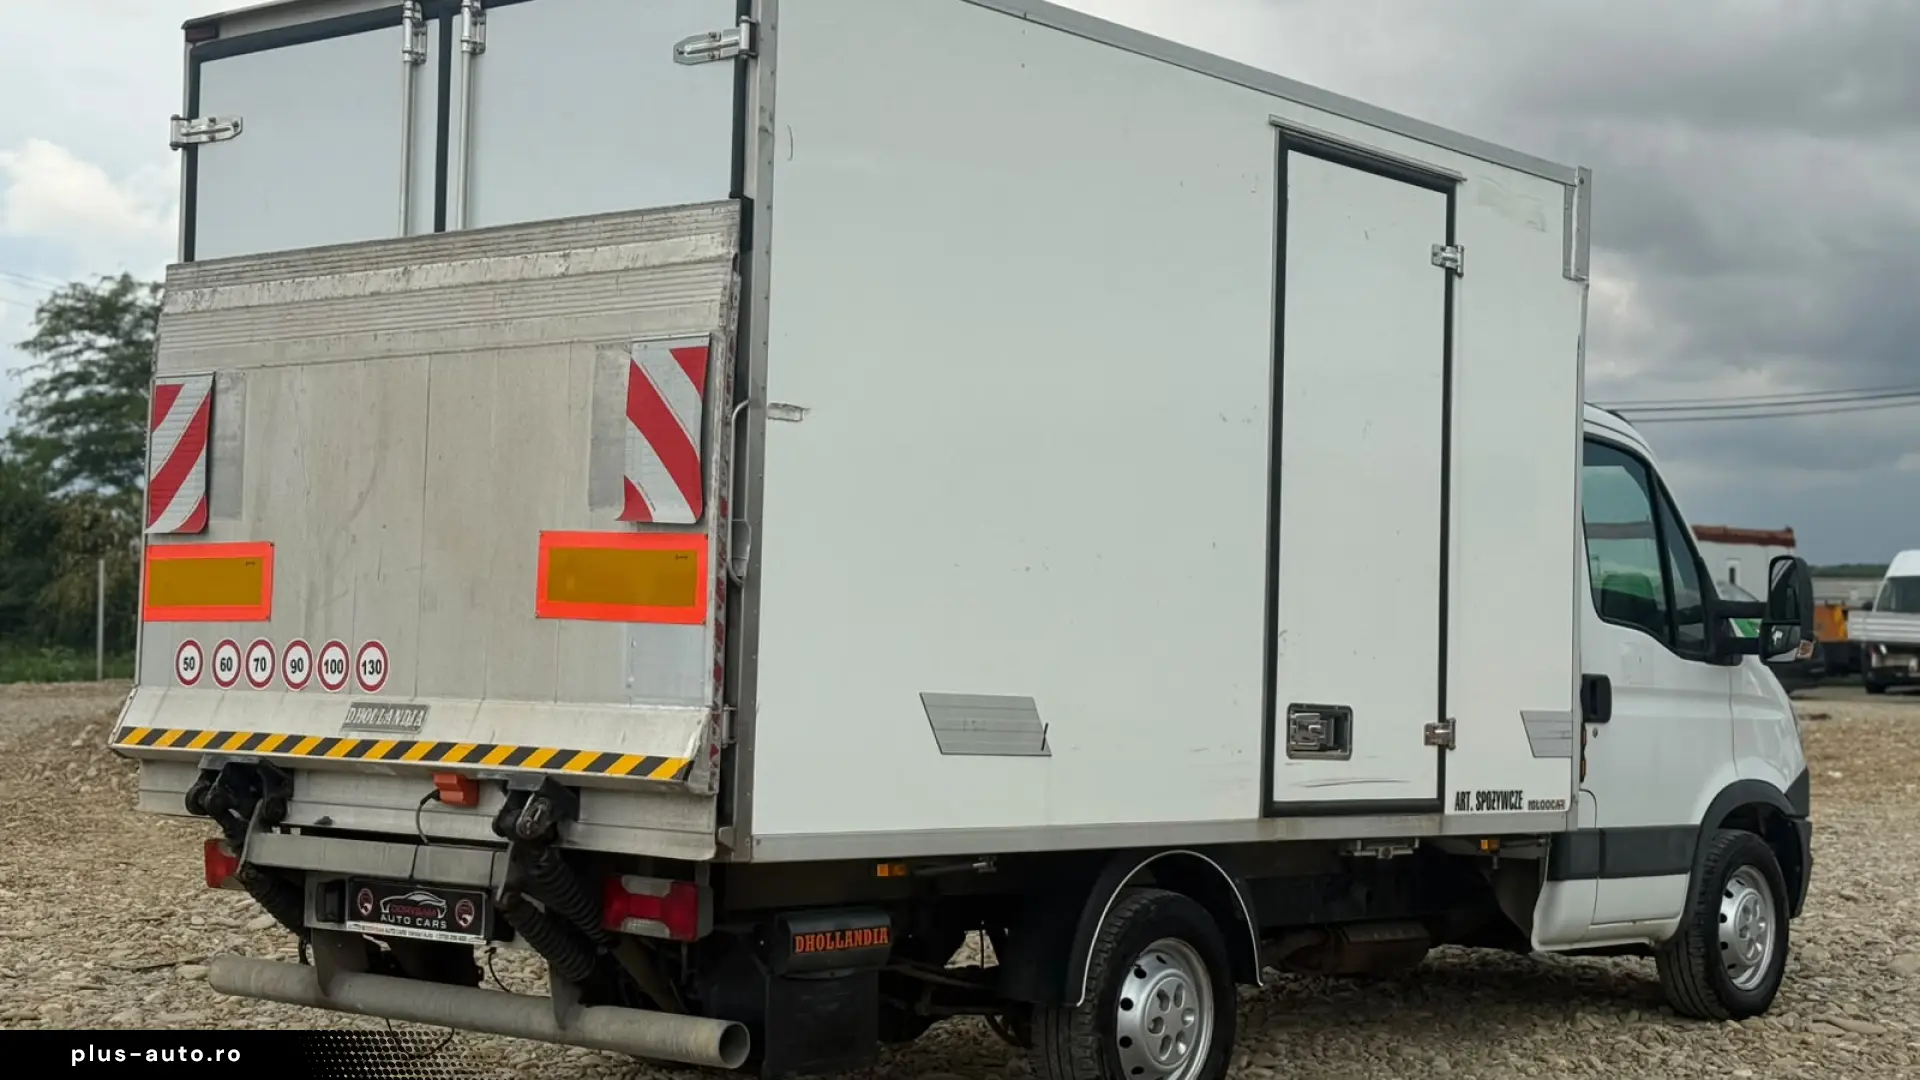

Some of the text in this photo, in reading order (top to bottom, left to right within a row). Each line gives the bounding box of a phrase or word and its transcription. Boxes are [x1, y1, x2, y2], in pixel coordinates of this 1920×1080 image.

[182, 656, 196, 672] 50
[219, 656, 233, 672] 60
[253, 656, 267, 673] 70
[289, 657, 304, 674] 90
[323, 659, 344, 675] 100
[361, 659, 382, 675] 130
[345, 707, 425, 727] DHOLLANDIA
[1454, 791, 1474, 811] ART.
[380, 914, 448, 930] AUTO CARS
[794, 927, 889, 954] DHOLLANDIA
